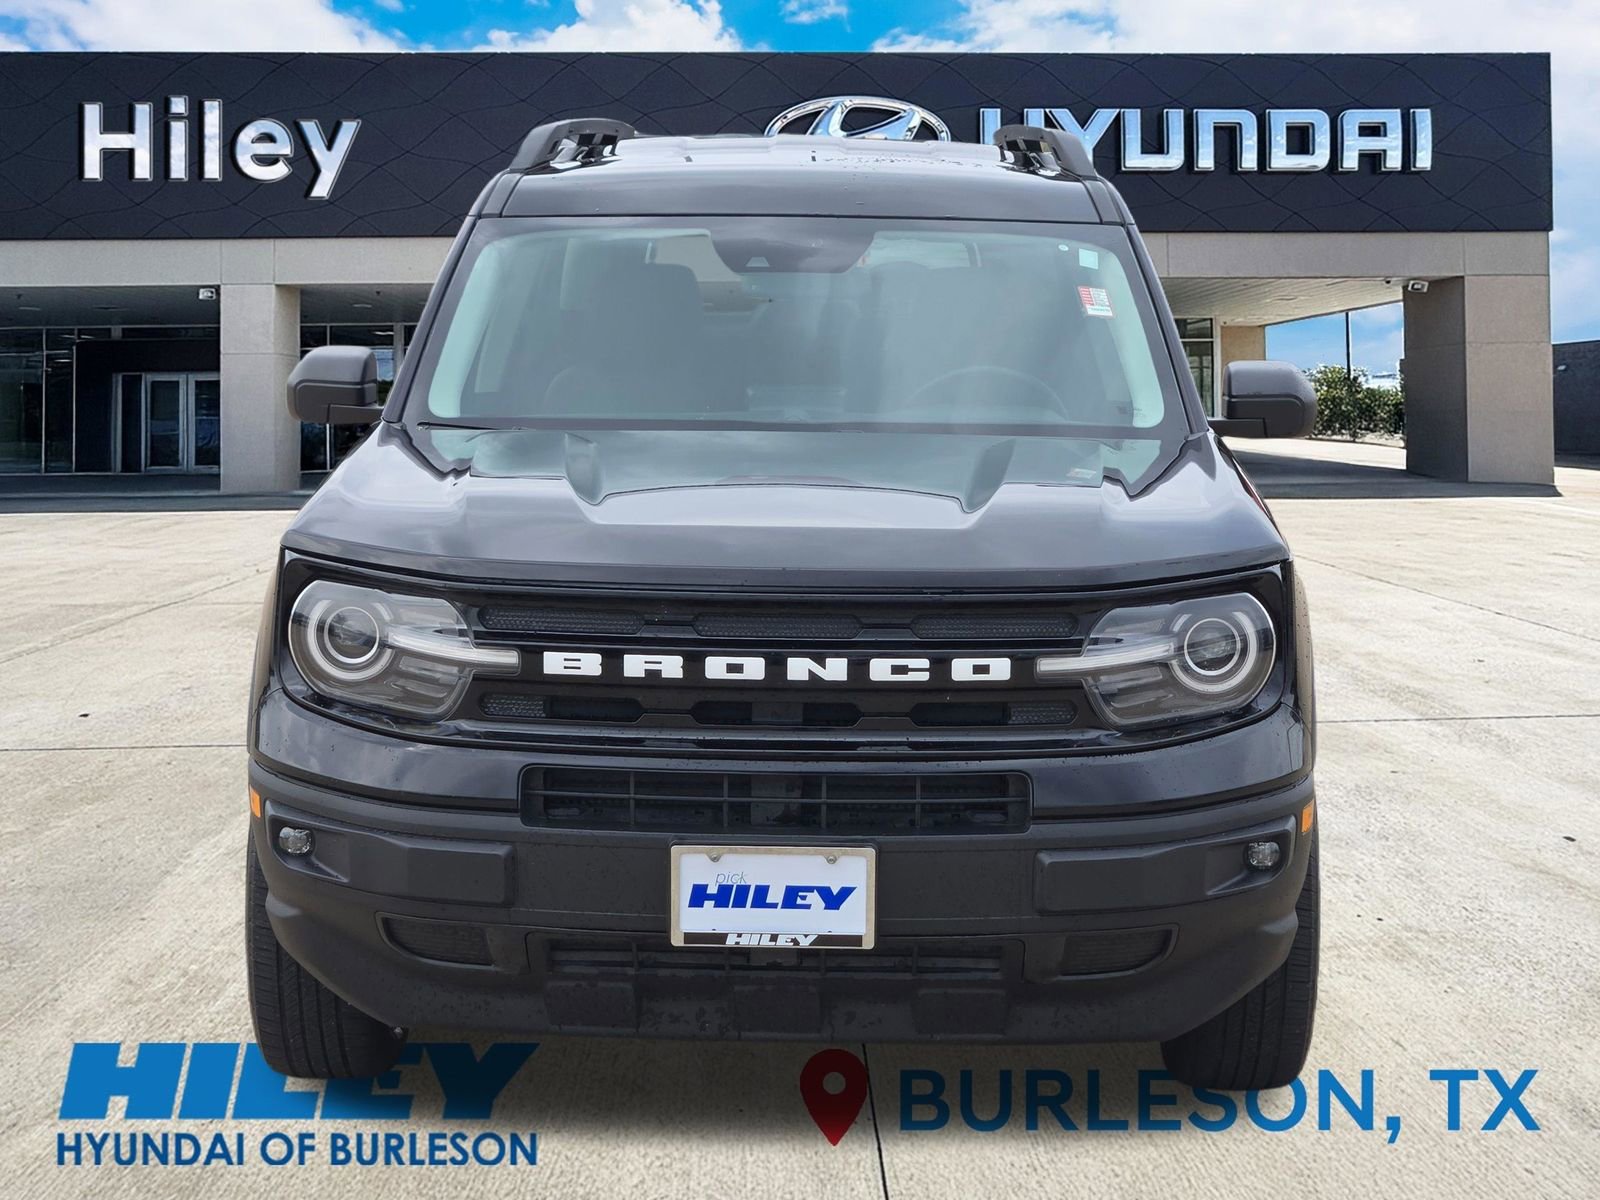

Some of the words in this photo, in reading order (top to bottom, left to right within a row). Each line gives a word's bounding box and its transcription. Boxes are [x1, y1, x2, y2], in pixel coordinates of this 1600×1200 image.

[80, 94, 362, 200] Hiley
[542, 650, 1012, 682] BRONCO
[714, 871, 748, 887] pick
[687, 882, 859, 911] HILEY
[724, 932, 820, 947] HILEY
